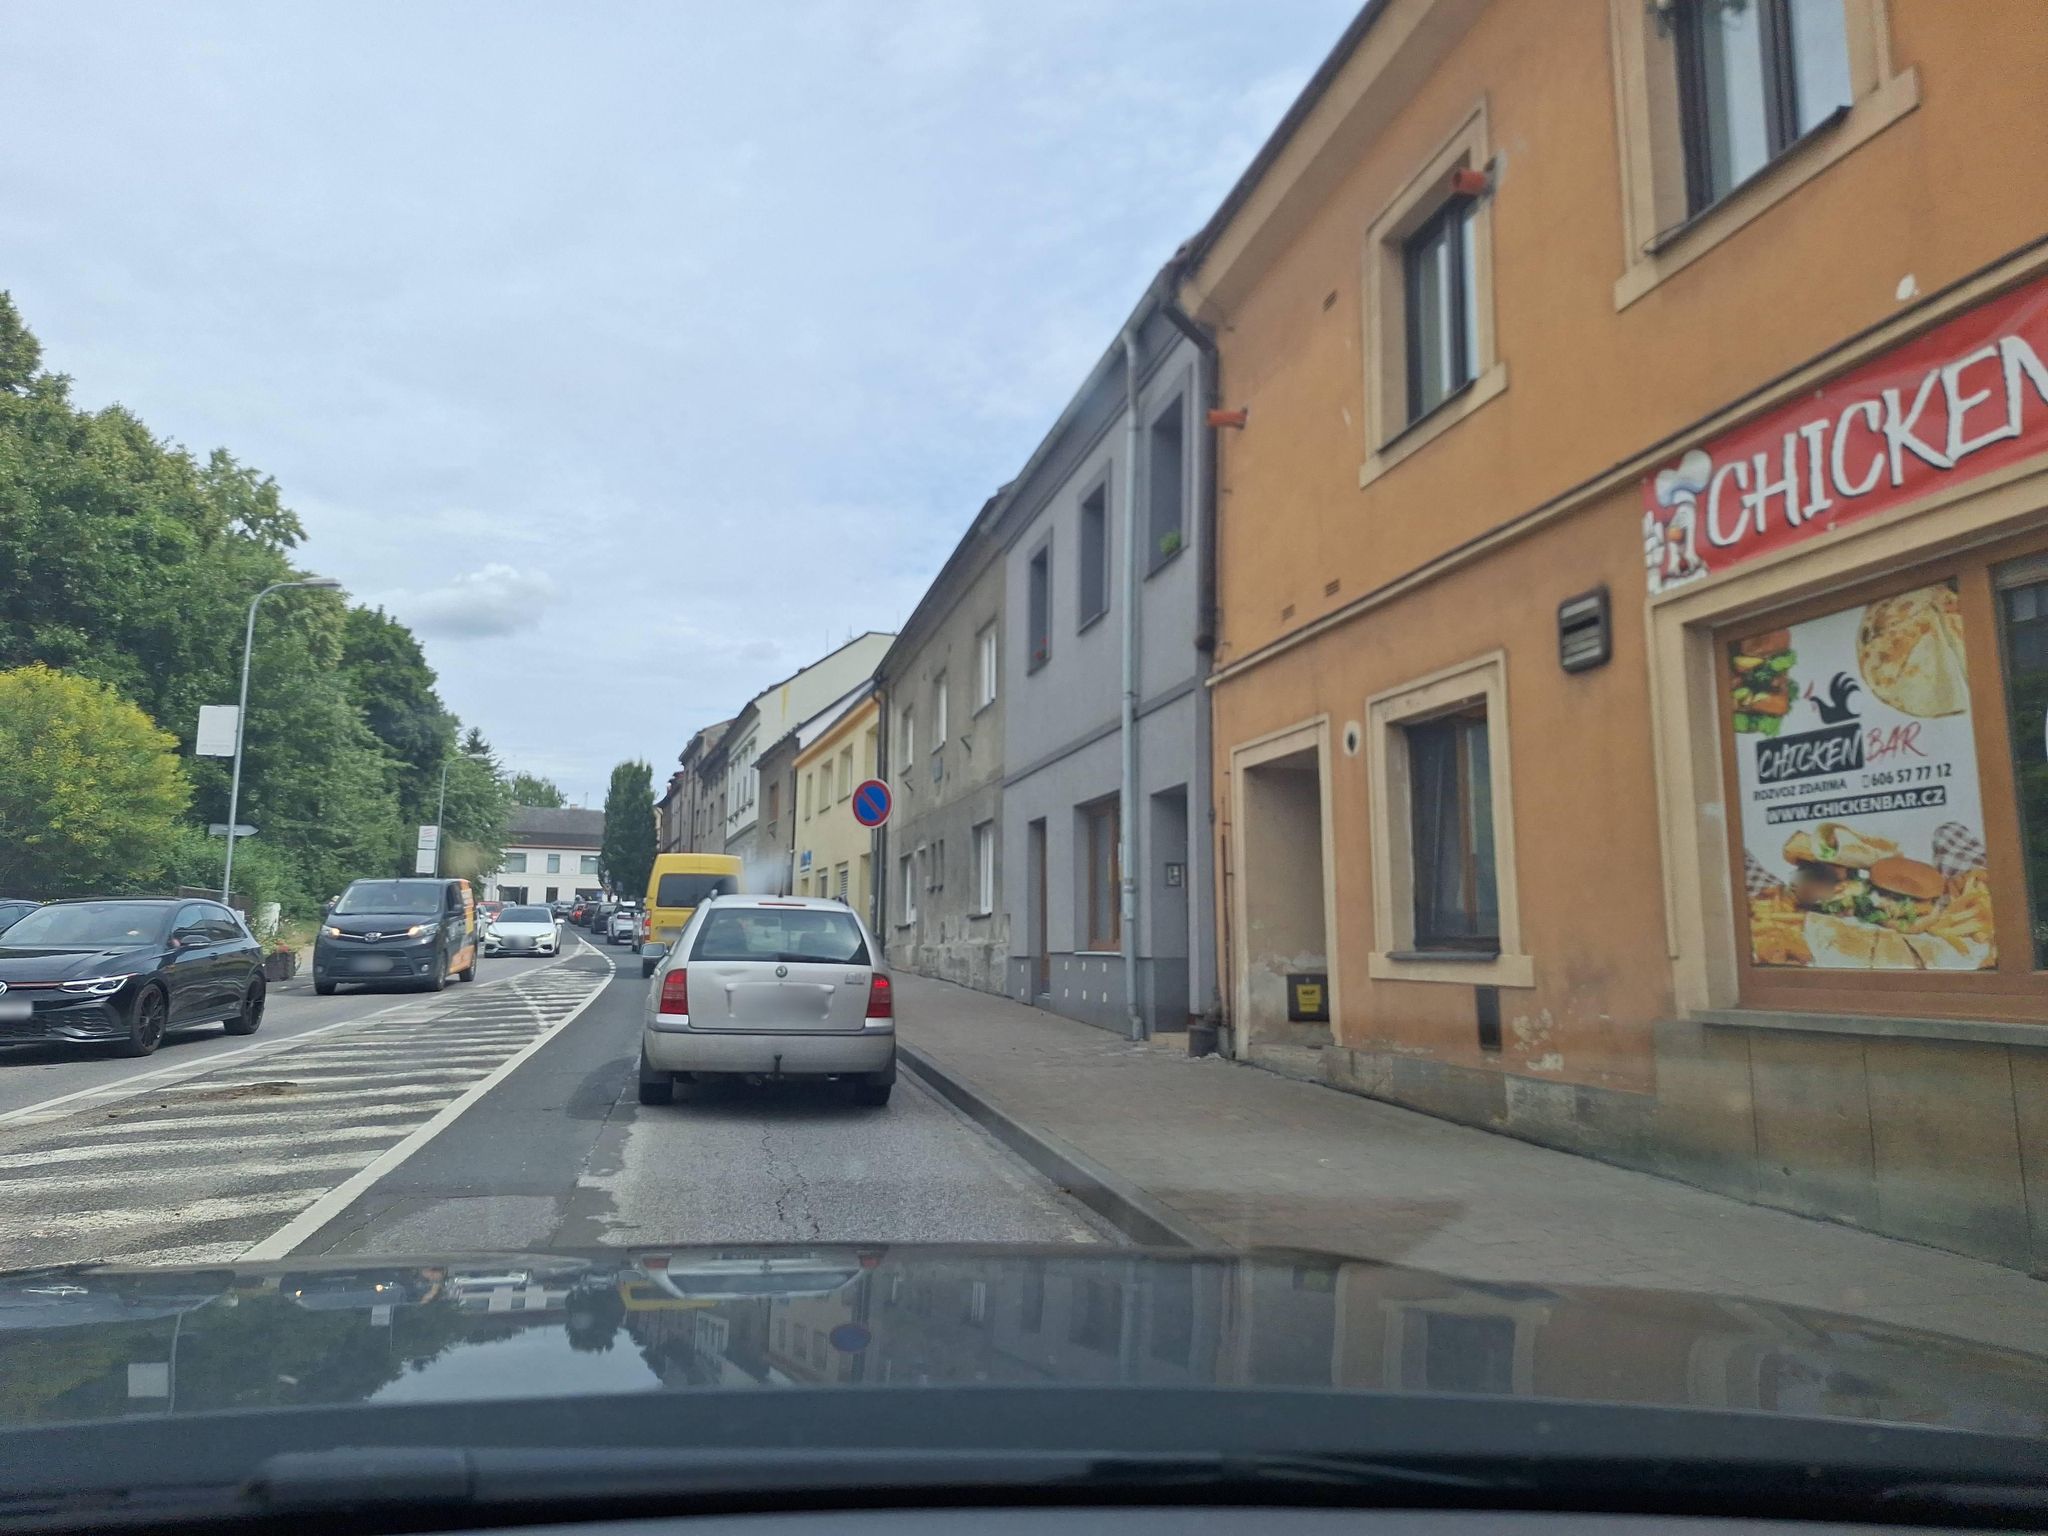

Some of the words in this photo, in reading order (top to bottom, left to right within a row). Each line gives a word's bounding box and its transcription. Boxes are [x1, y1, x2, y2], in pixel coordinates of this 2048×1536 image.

[1706, 335, 2048, 547] CHICKEN
[1760, 729, 1862, 778] CHICKEN
[1866, 721, 1929, 762] BAR
[1871, 771, 1895, 787] 606
[1896, 768, 1912, 783] 57
[1915, 765, 1932, 780] 77
[1936, 762, 1952, 777] 12
[1767, 788, 1945, 821] WWW.CHICKENBAR.CZ
